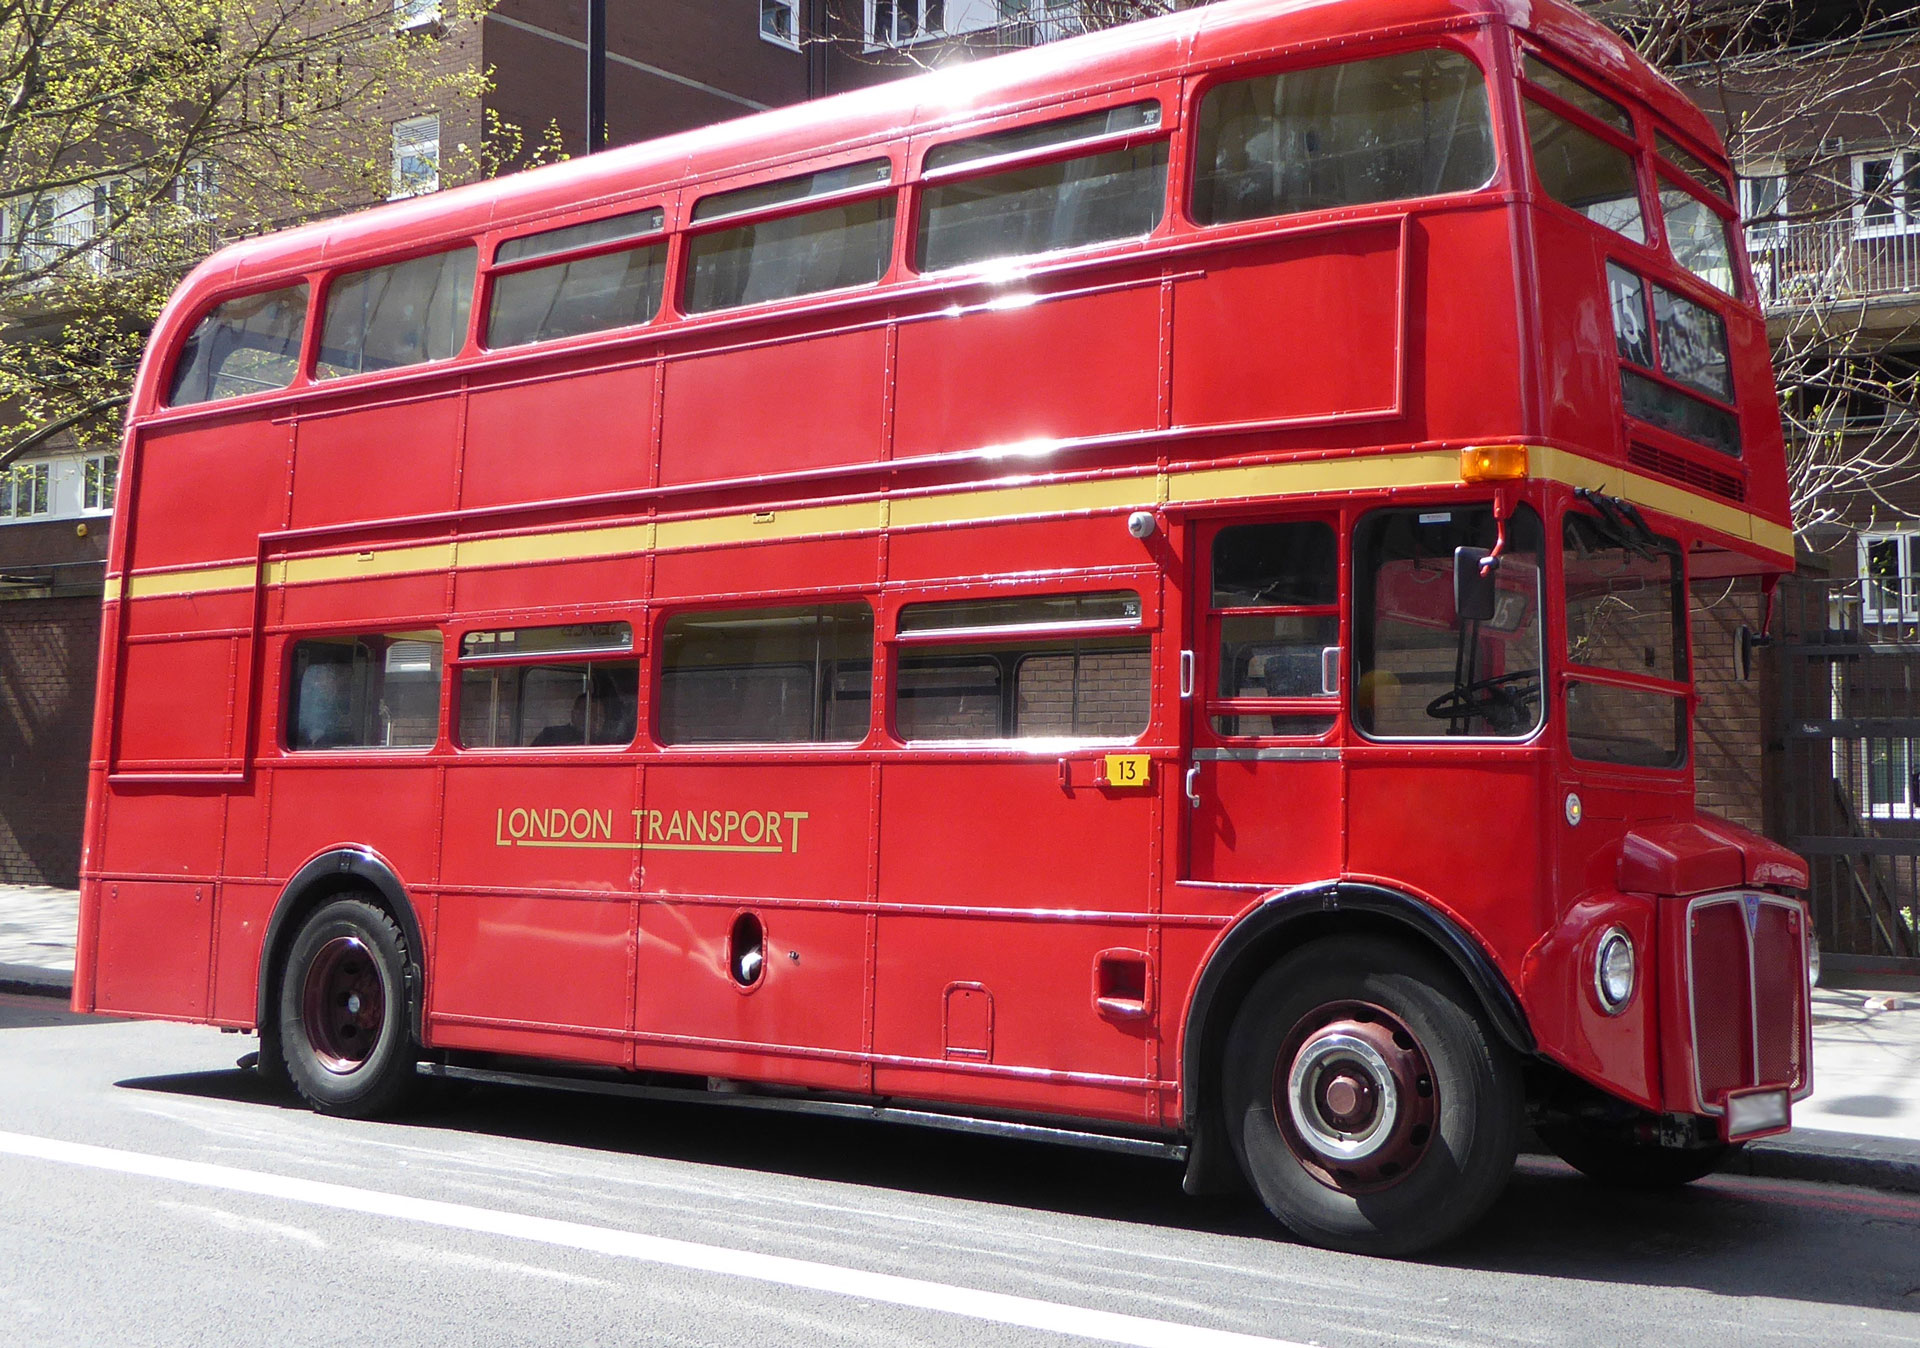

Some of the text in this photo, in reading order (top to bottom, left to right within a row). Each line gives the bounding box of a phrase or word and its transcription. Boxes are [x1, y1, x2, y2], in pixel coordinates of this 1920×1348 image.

[1610, 279, 1640, 345] 15
[1118, 760, 1136, 780] 13
[495, 808, 809, 853] LONDON TRANSPORT
